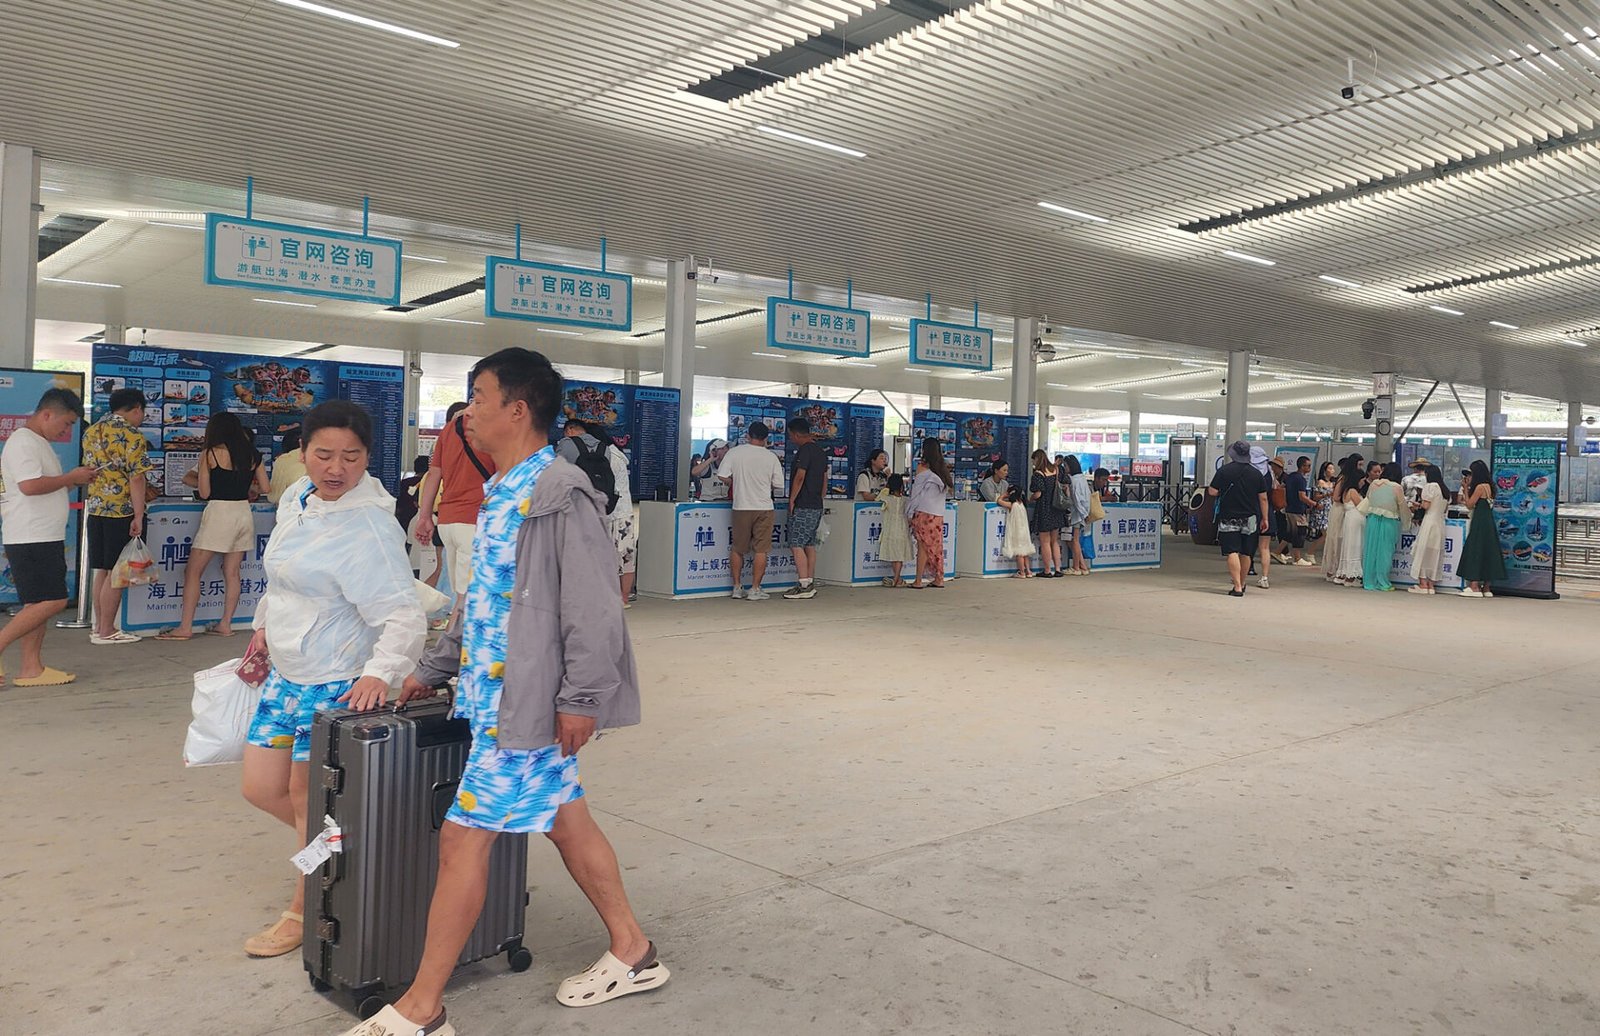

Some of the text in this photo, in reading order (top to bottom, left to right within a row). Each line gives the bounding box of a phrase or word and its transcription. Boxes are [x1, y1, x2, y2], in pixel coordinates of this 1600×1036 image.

[280, 238, 374, 269] 官网咨询
[542, 275, 611, 300] 官网咨询
[808, 312, 856, 332] 官网咨询
[942, 331, 982, 349] 官网咨询
[1494, 446, 1555, 458] 海上大玩家
[1118, 519, 1156, 534] 官网咨询
